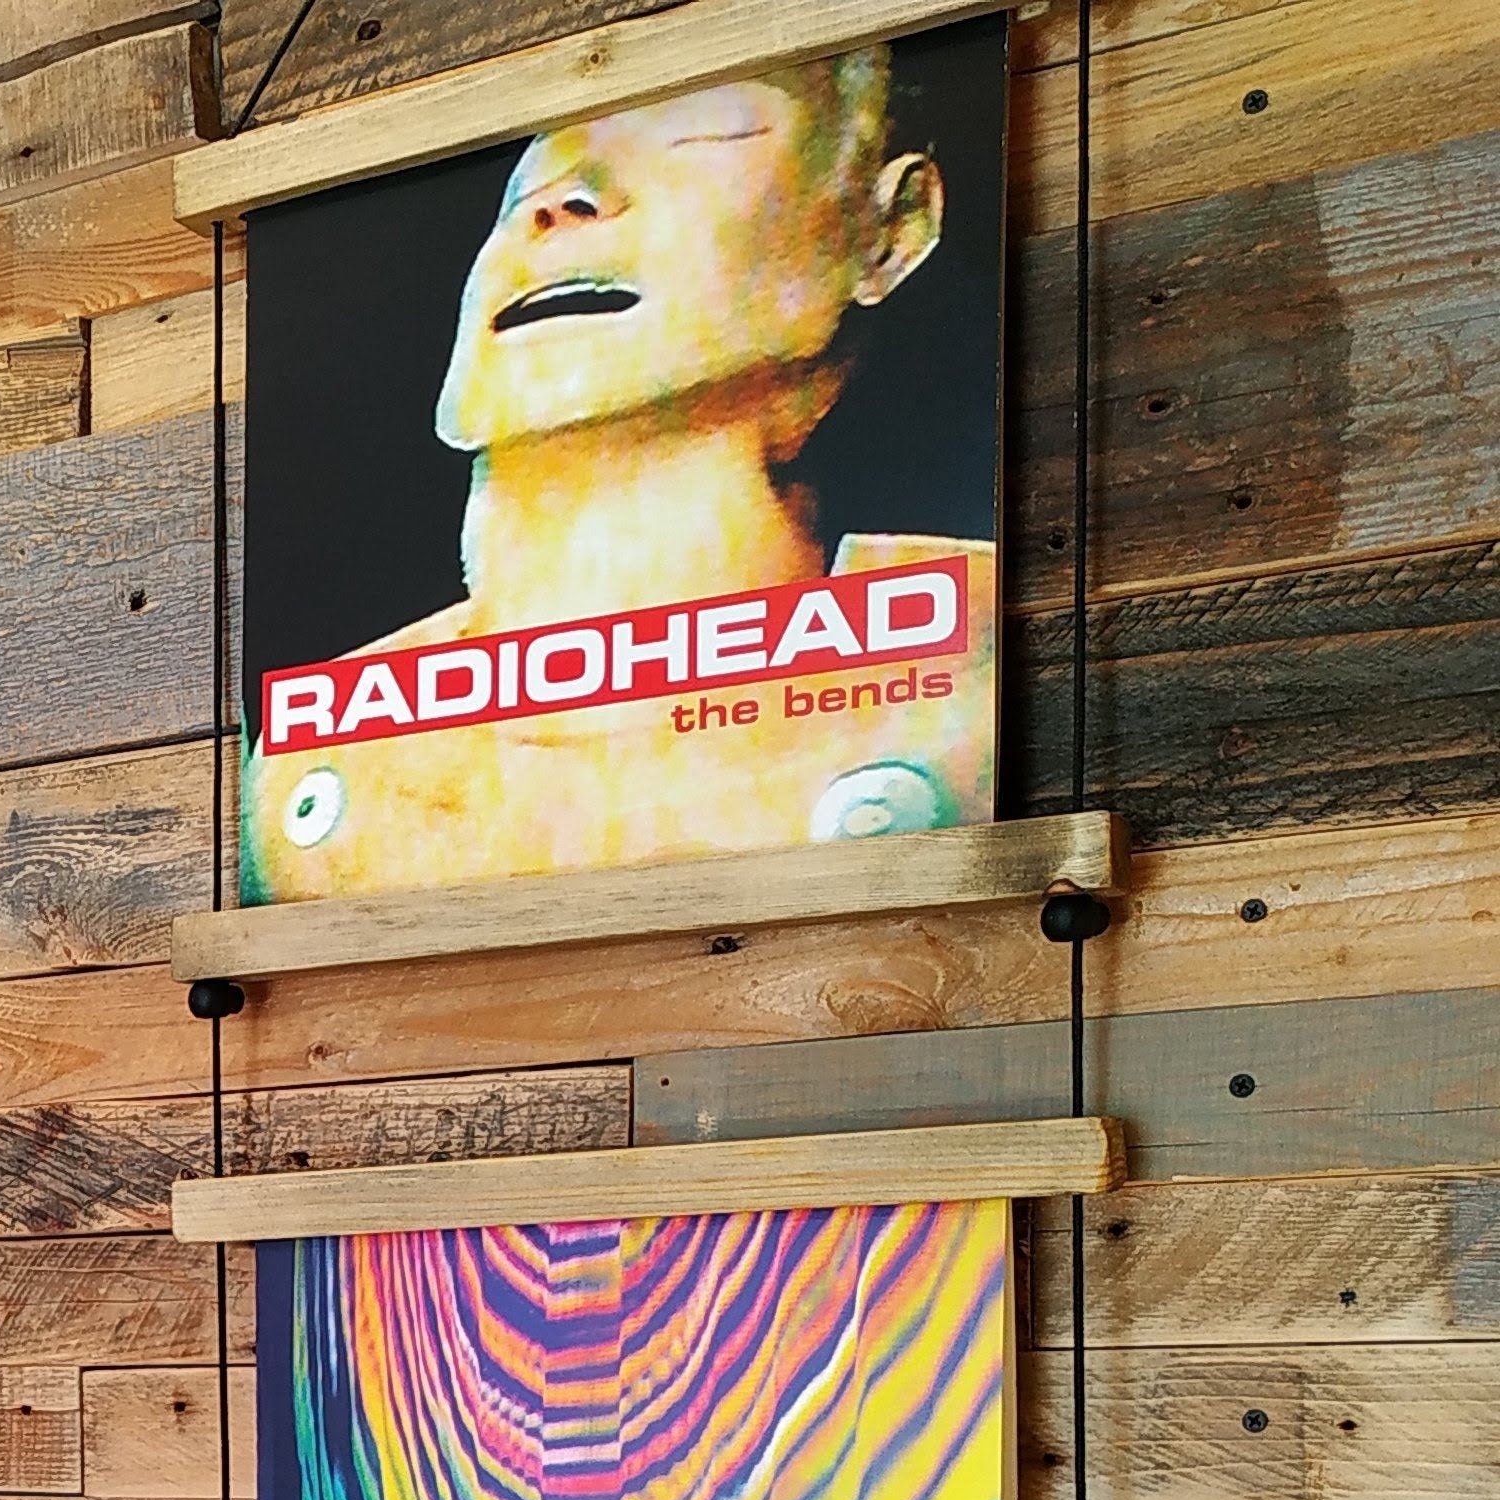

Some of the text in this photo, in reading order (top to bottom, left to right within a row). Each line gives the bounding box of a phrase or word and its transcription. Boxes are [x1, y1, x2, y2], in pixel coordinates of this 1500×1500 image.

[268, 572, 960, 745] RADIOHEAD
[670, 667, 955, 734] the bends
